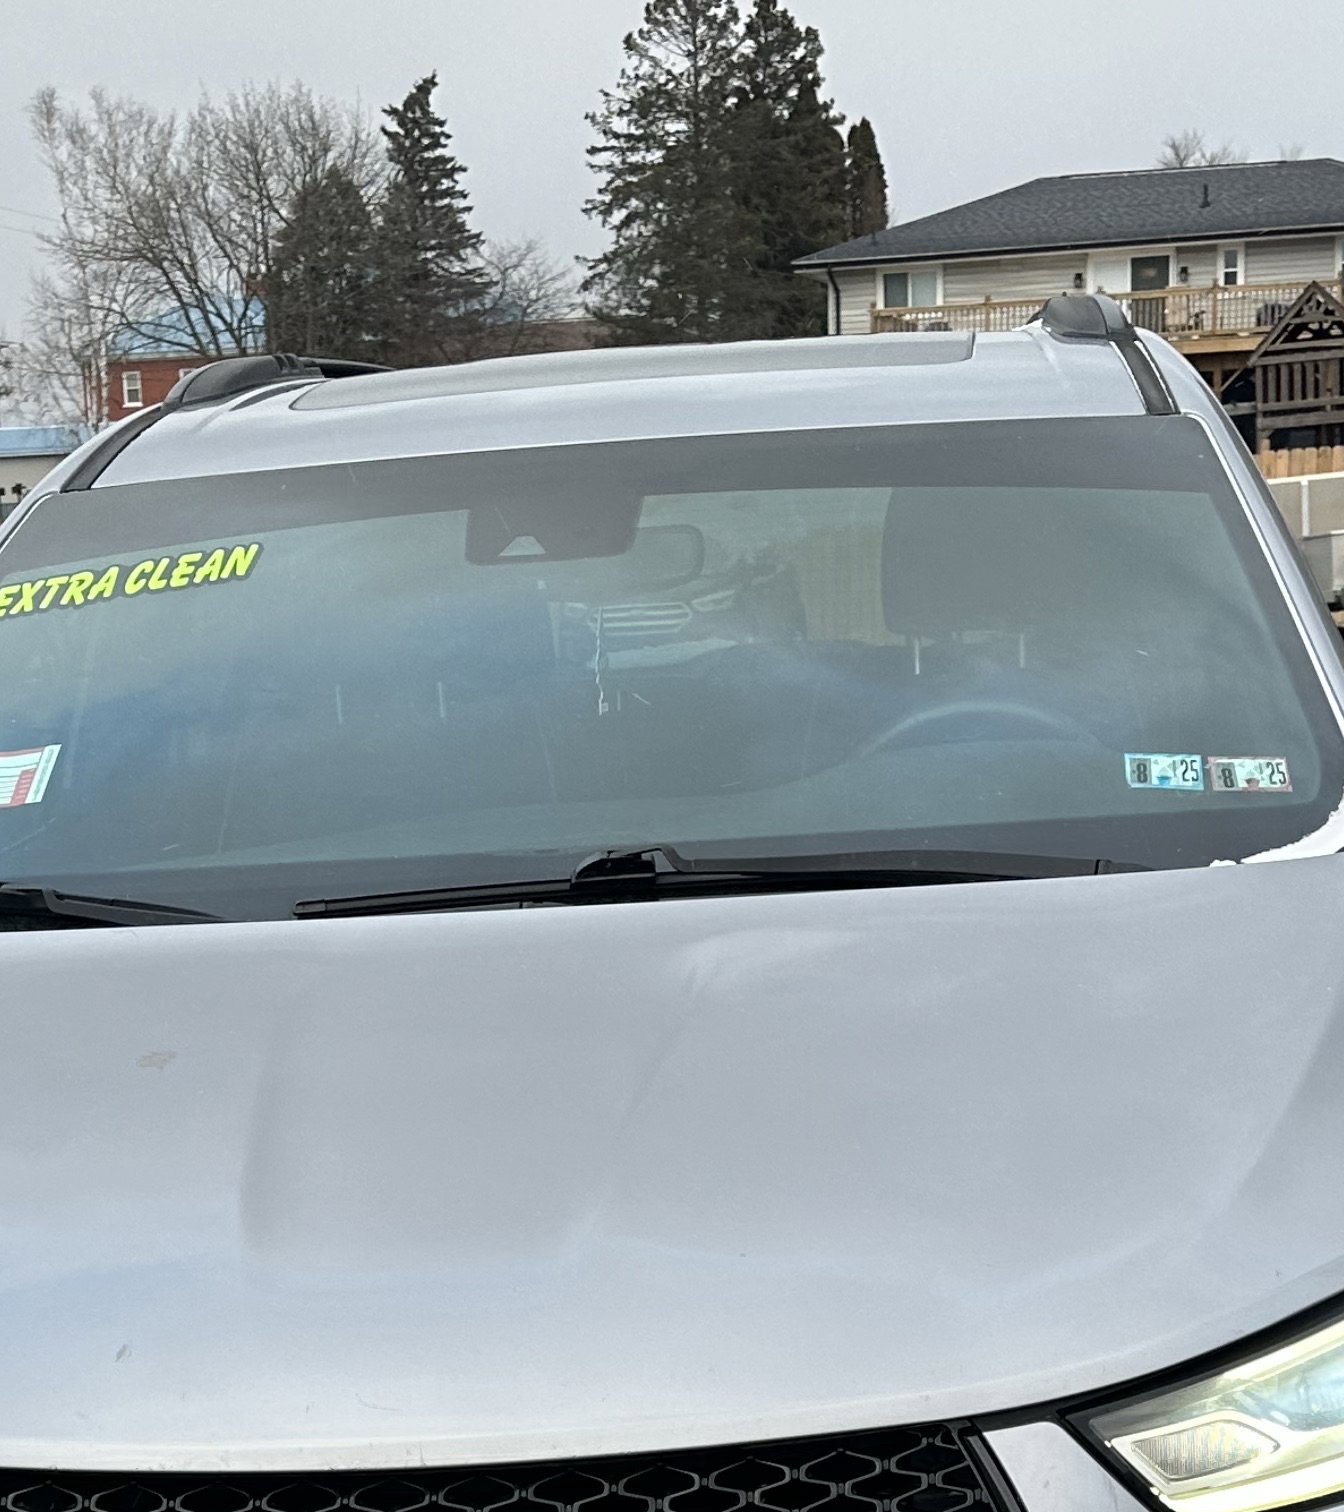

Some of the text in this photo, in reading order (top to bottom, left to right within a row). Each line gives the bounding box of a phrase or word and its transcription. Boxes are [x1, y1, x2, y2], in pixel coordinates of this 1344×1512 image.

[124, 543, 260, 596] CLEAN
[1136, 759, 1199, 783] 8 25
[1221, 762, 1287, 788] 8 25
